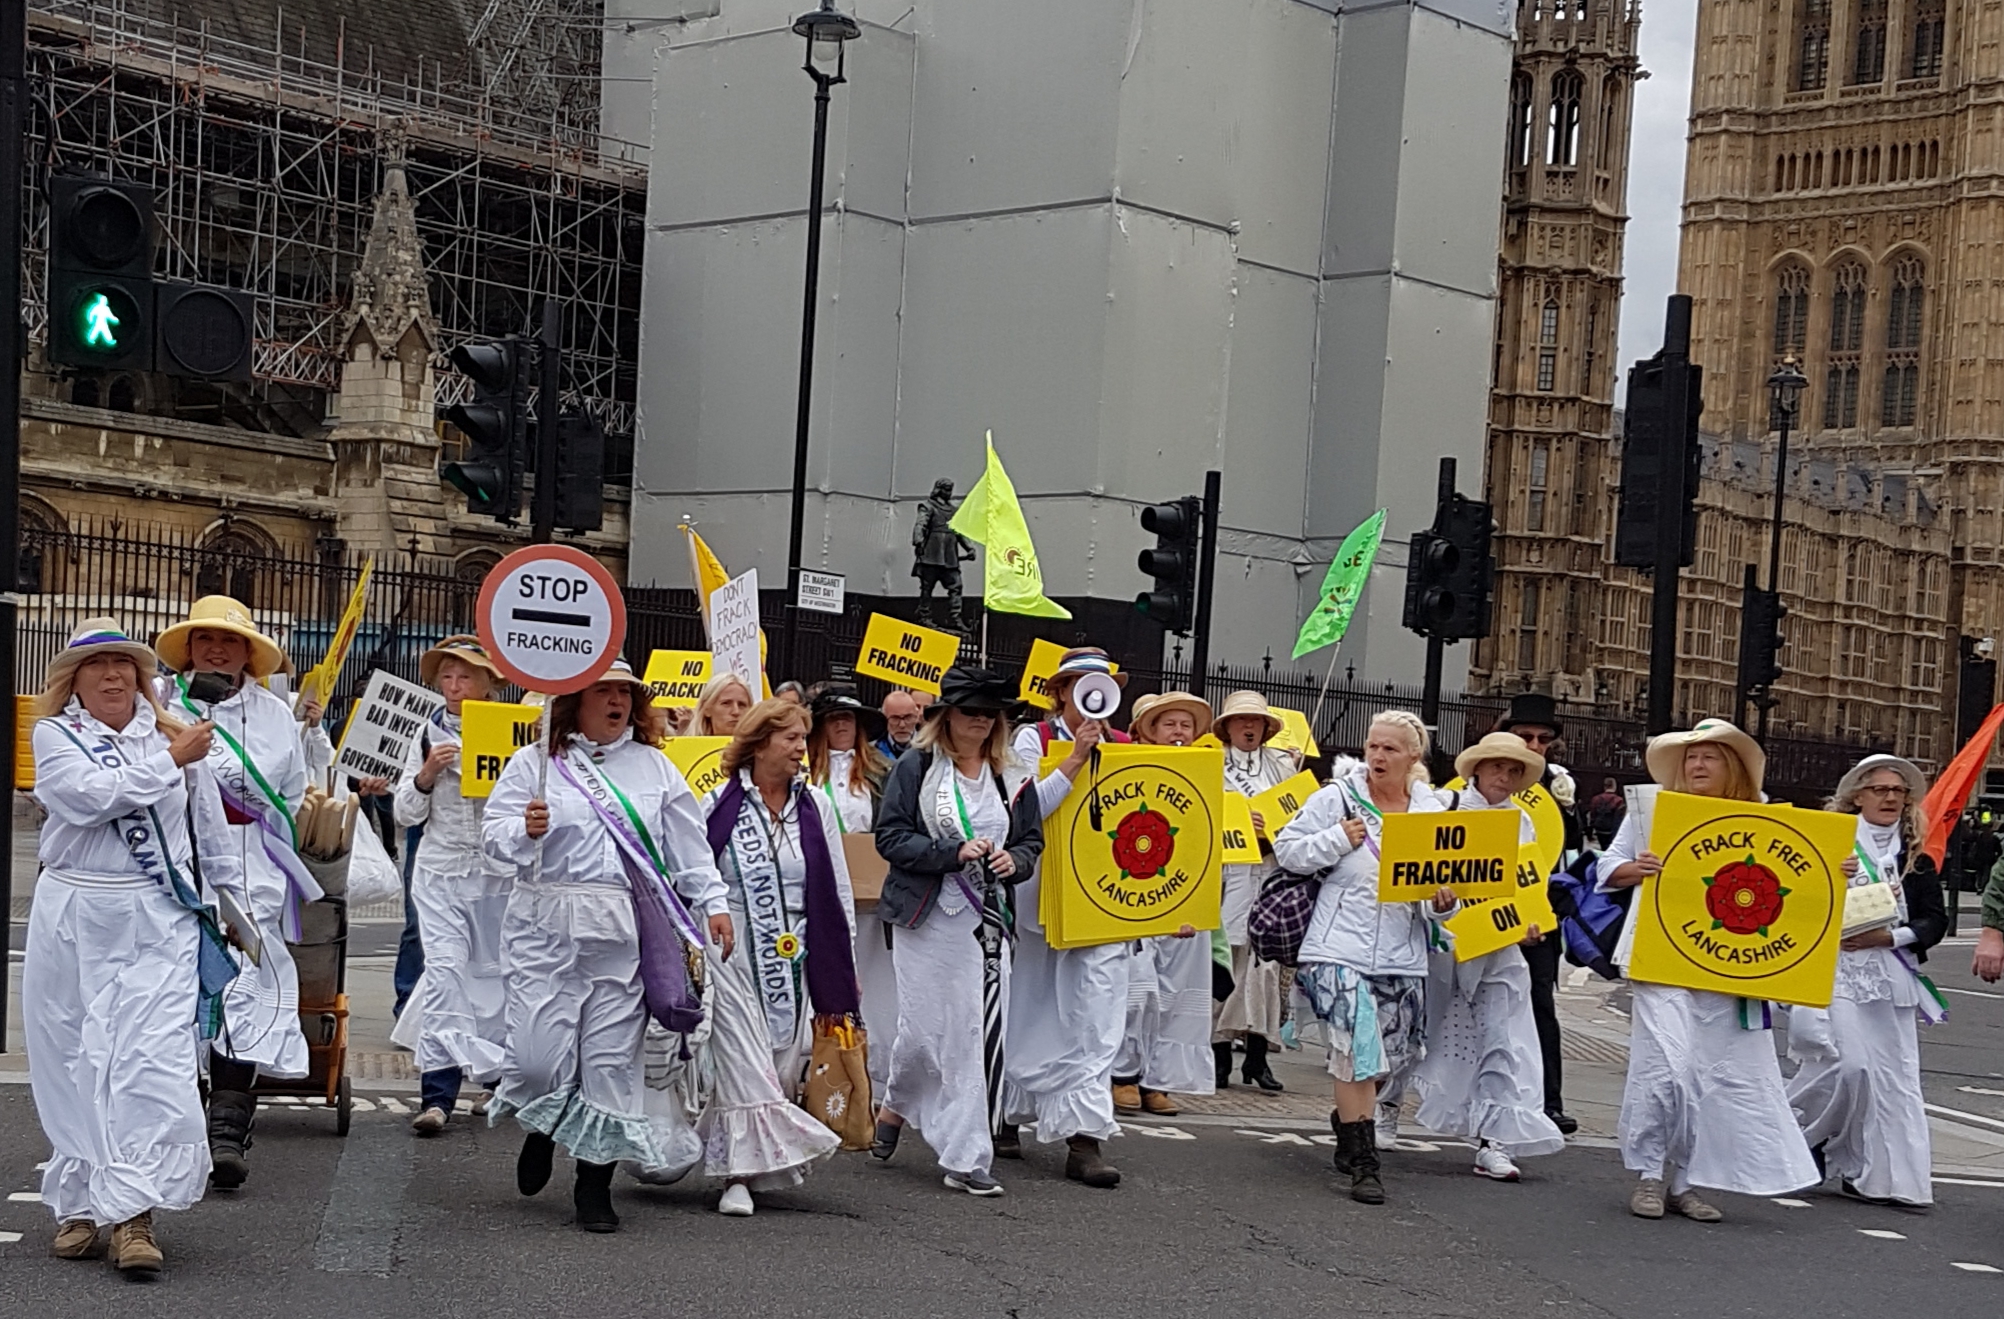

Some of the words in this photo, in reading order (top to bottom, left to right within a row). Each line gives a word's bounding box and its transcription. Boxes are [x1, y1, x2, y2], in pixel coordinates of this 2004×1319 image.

[519, 573, 589, 603] STOP
[716, 597, 752, 630] FRACK
[507, 631, 593, 655] FRACKING
[899, 632, 923, 653] NO
[681, 660, 704, 677] NO
[867, 647, 942, 684] FRACKING
[379, 682, 406, 706] HOW
[403, 692, 437, 719] MANY
[650, 680, 705, 699] FRACKI
[1028, 675, 1050, 697] FR
[366, 704, 389, 727] BAD
[388, 713, 419, 740] INVES
[378, 734, 403, 760] WILL
[340, 747, 404, 786] GOVERNMEN
[476, 754, 511, 781] FR
[1156, 783, 1193, 815] FREE
[1277, 792, 1299, 815] NO
[1222, 829, 1247, 849] NG
[1435, 825, 1466, 850] NO
[1690, 831, 1756, 860] FRACK
[1767, 838, 1812, 877] FREE
[1392, 858, 1504, 886] FRACKING
[750, 875, 779, 924] NOT
[1096, 868, 1189, 907] LANCASHIRE
[1491, 903, 1522, 932] NO
[1681, 919, 1797, 964] LANCASHIRE
